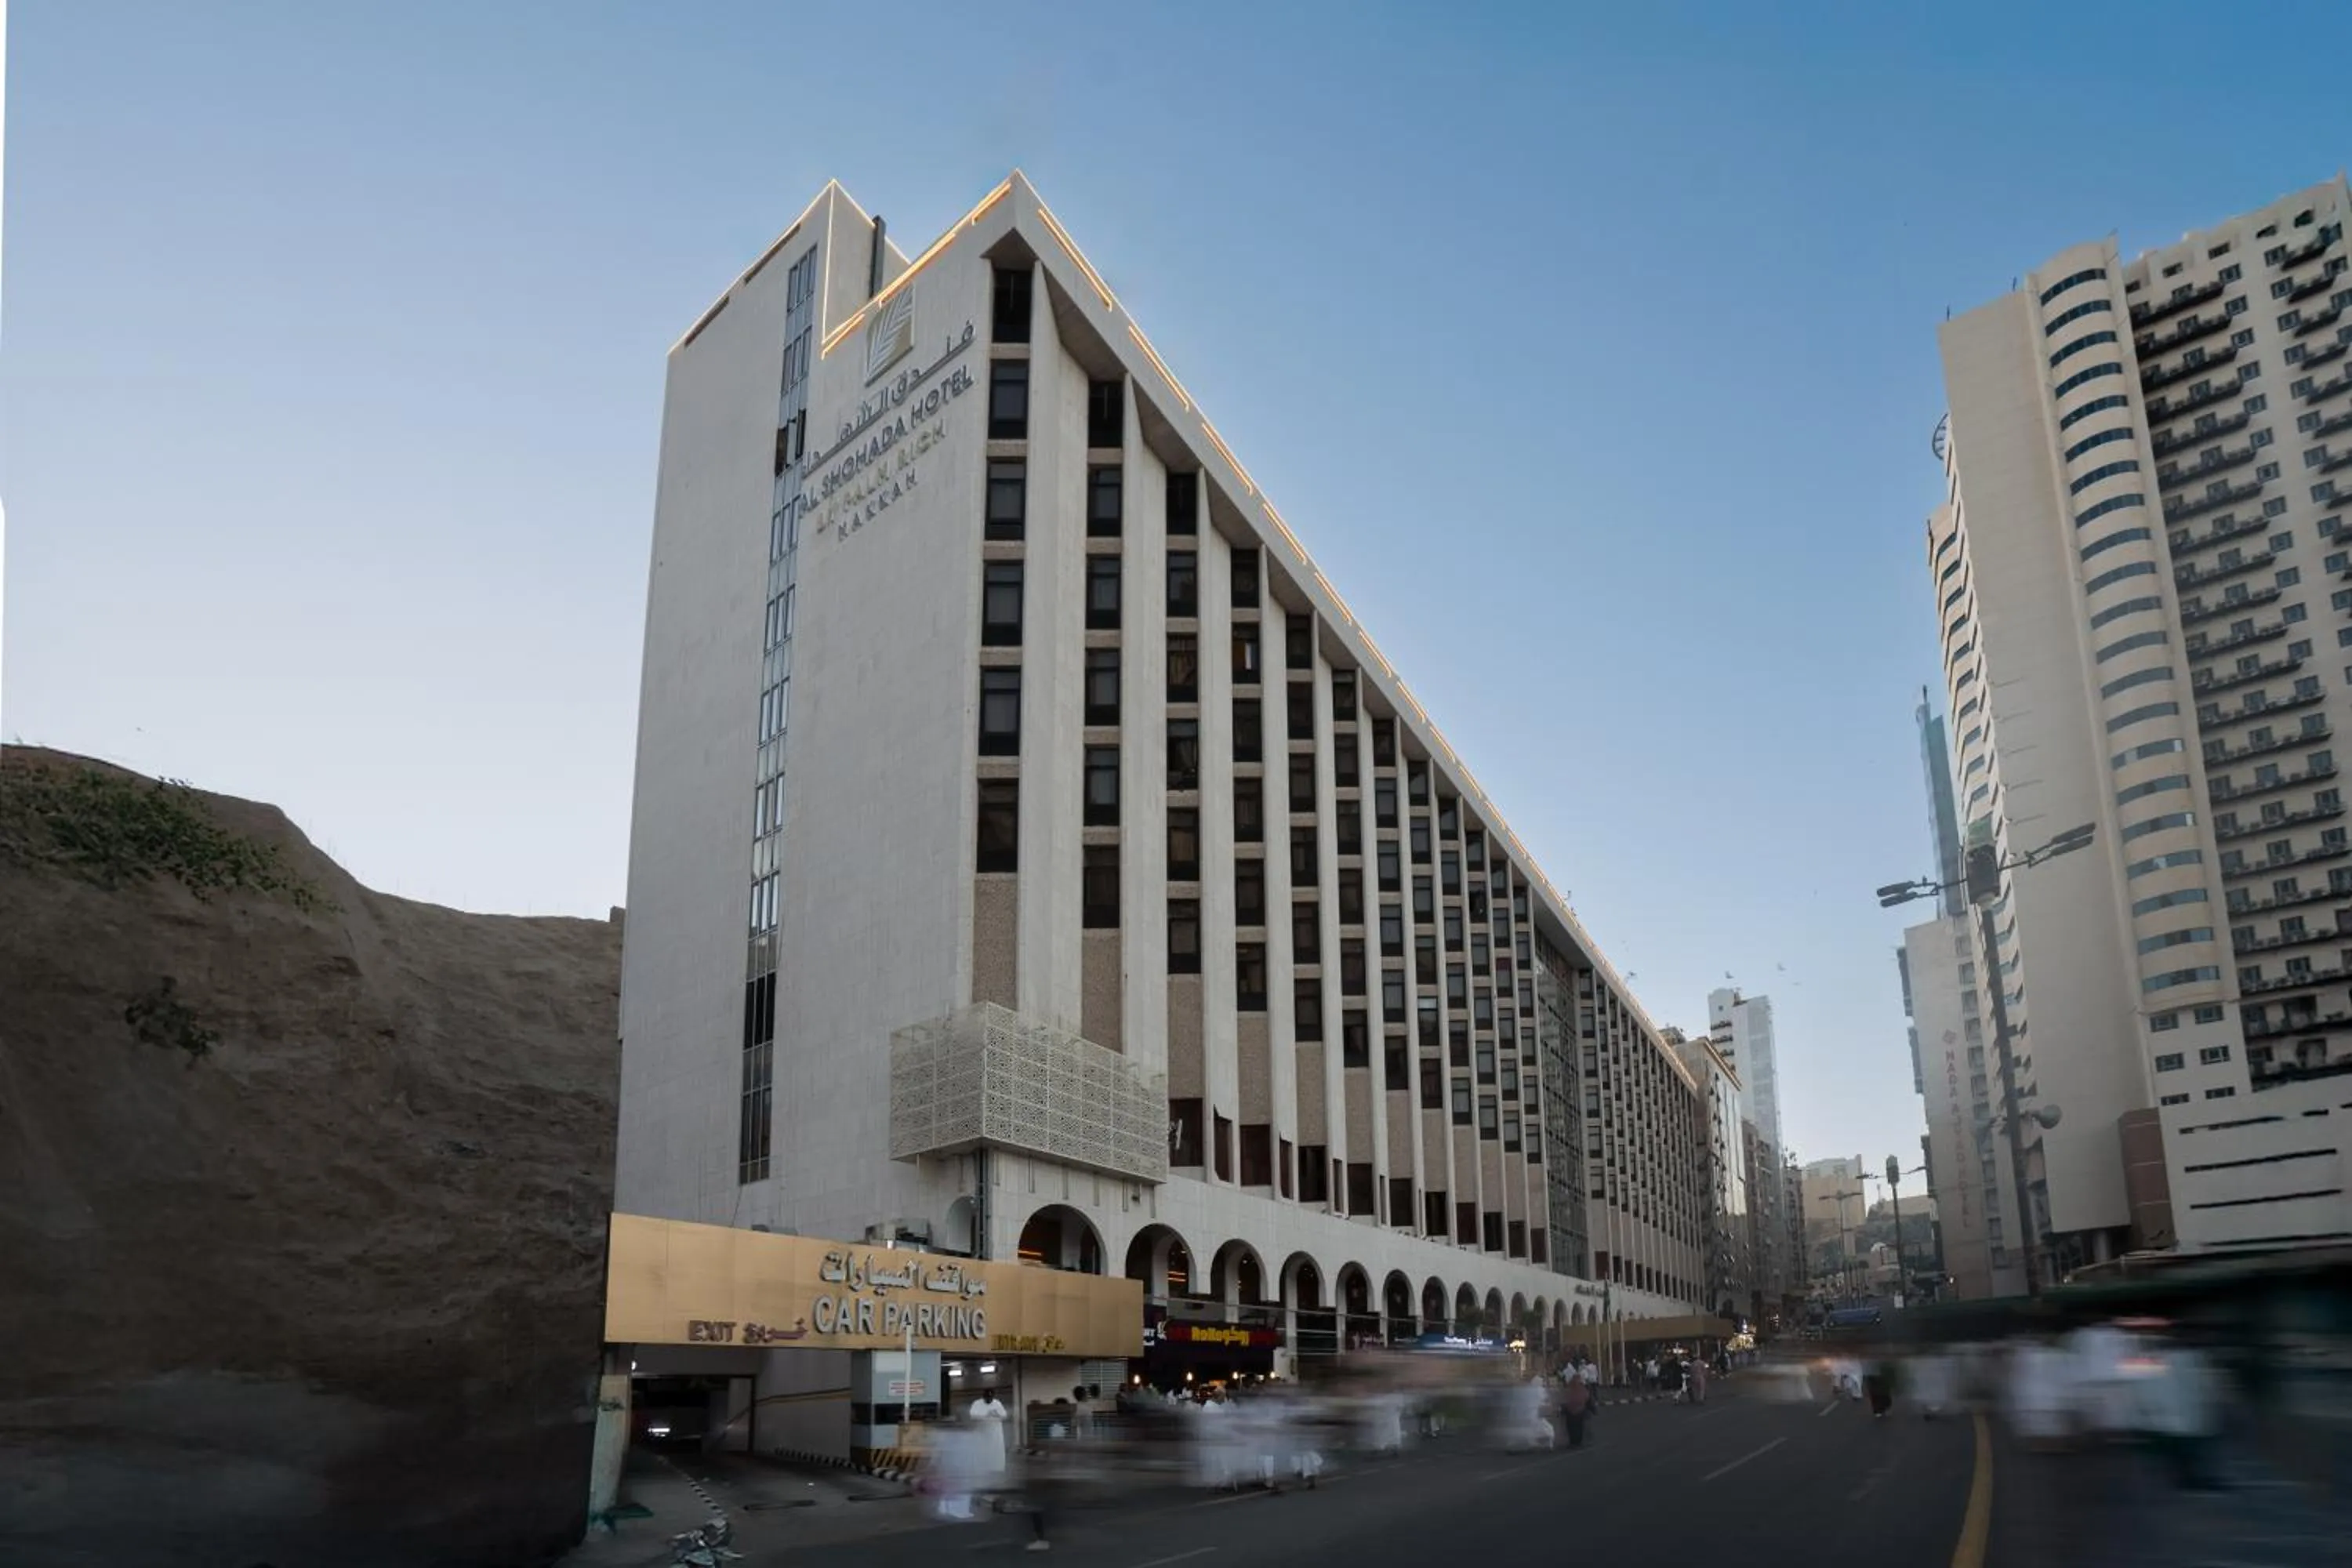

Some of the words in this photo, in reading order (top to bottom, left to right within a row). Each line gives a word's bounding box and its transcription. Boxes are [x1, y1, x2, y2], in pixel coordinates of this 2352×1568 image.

[821, 416, 909, 499] SHOHADA
[910, 365, 975, 429] HOTEL
[819, 1250, 924, 1296] السيارات
[924, 1262, 987, 1301] مواقف
[688, 1319, 737, 1343] EXIT
[815, 1294, 876, 1334] CAR
[883, 1301, 987, 1340] PARKING
